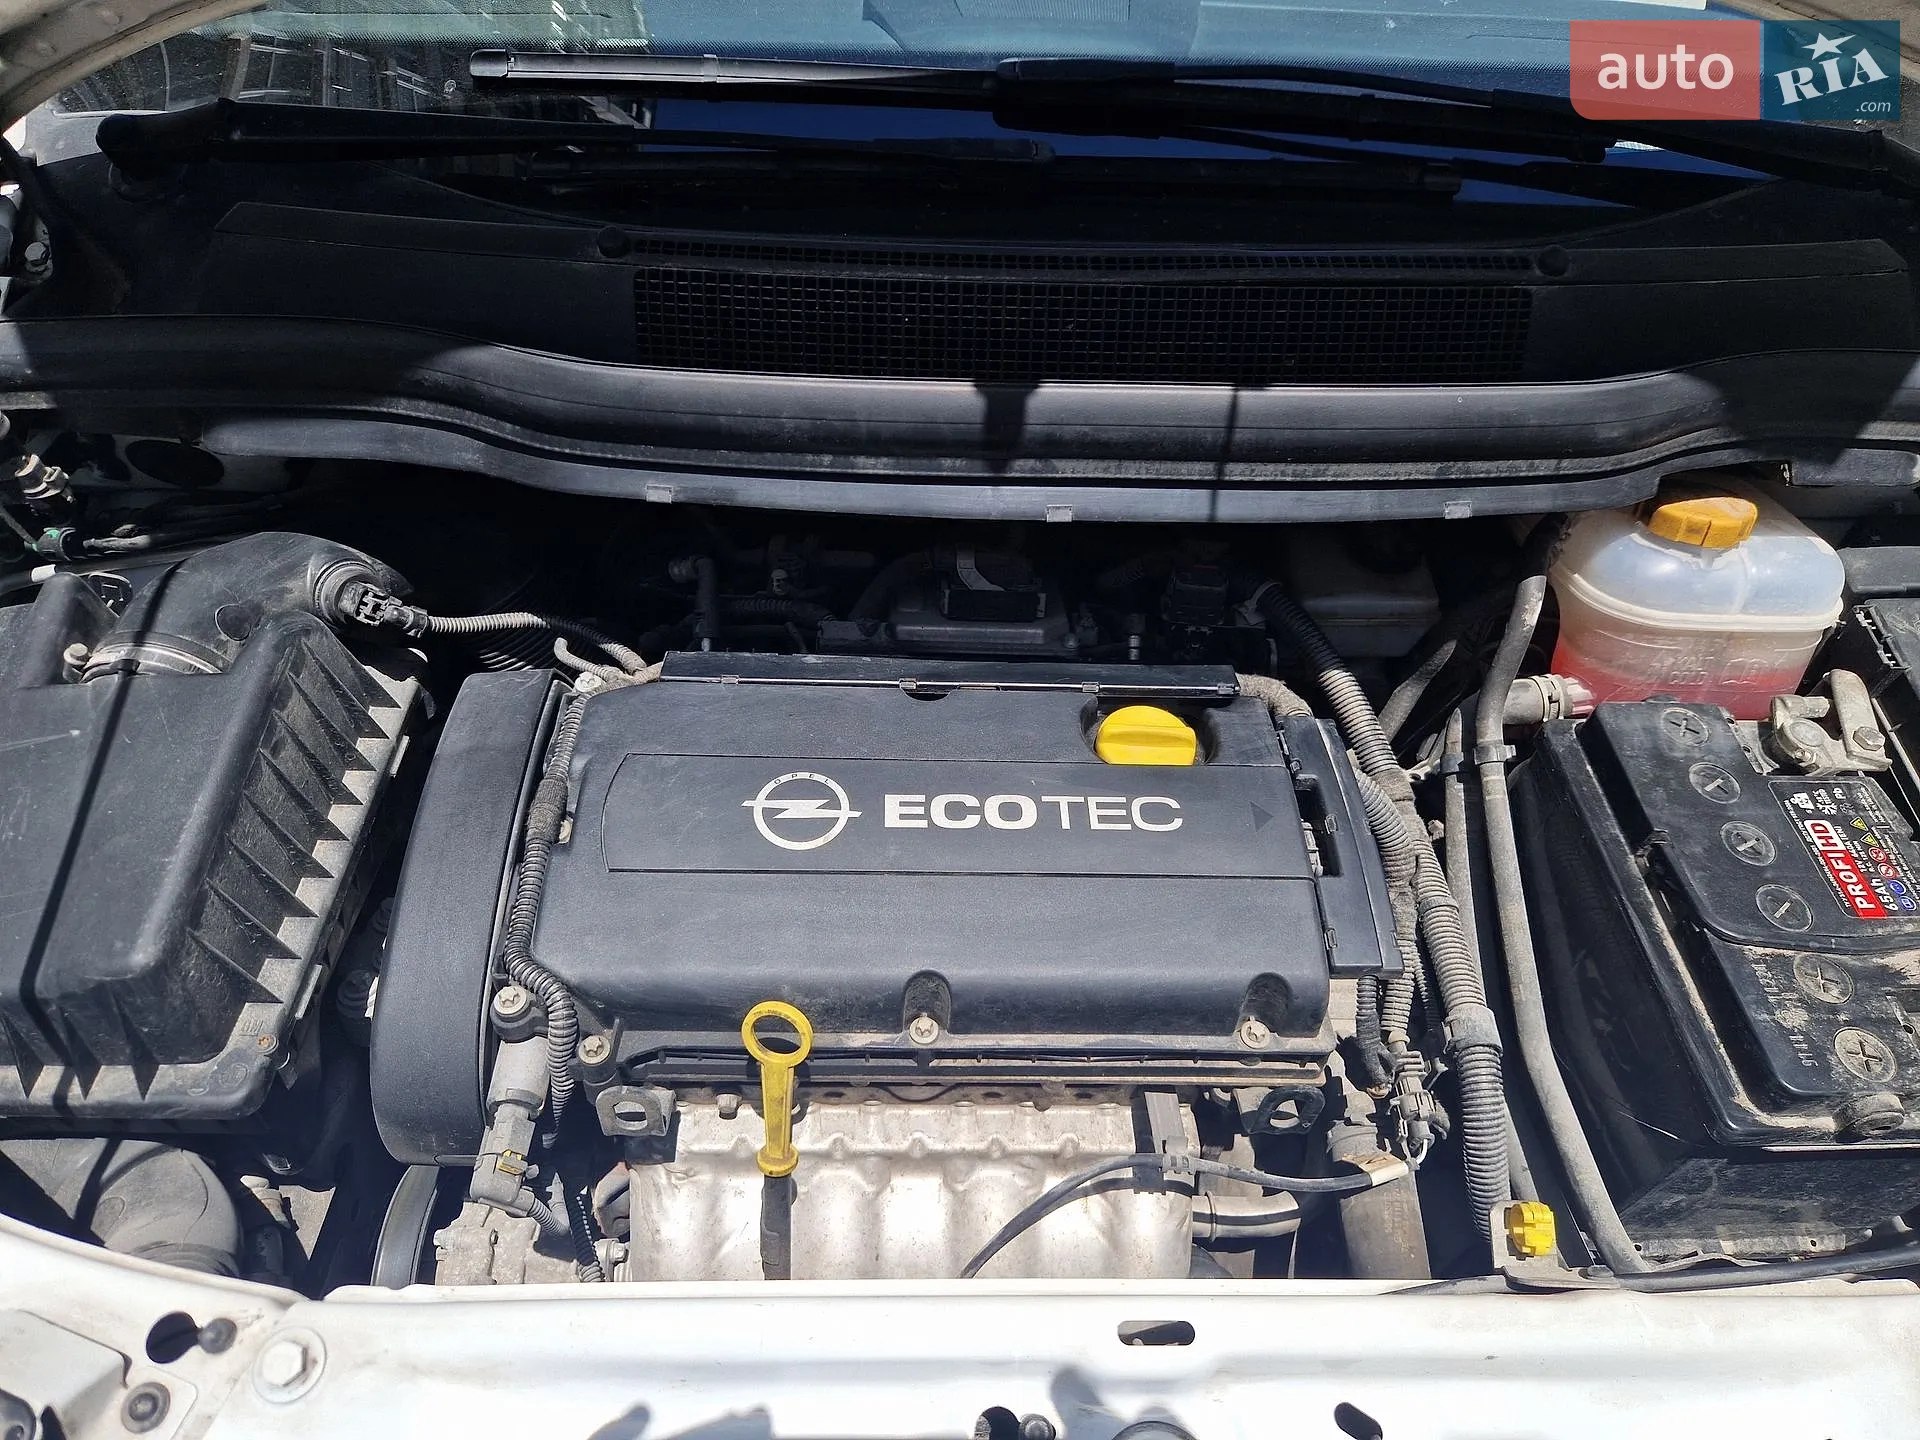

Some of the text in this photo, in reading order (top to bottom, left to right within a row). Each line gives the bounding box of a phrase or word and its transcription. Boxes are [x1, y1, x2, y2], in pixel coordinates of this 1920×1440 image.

[774, 773, 830, 785] OPEL
[1833, 787, 1847, 799] Pb
[884, 794, 1183, 832] ECOTEC
[1810, 823, 1839, 848] HD
[1855, 860, 1868, 873] 12V
[1826, 850, 1876, 911] PROFI
[1870, 878, 1899, 911] 65Ah
